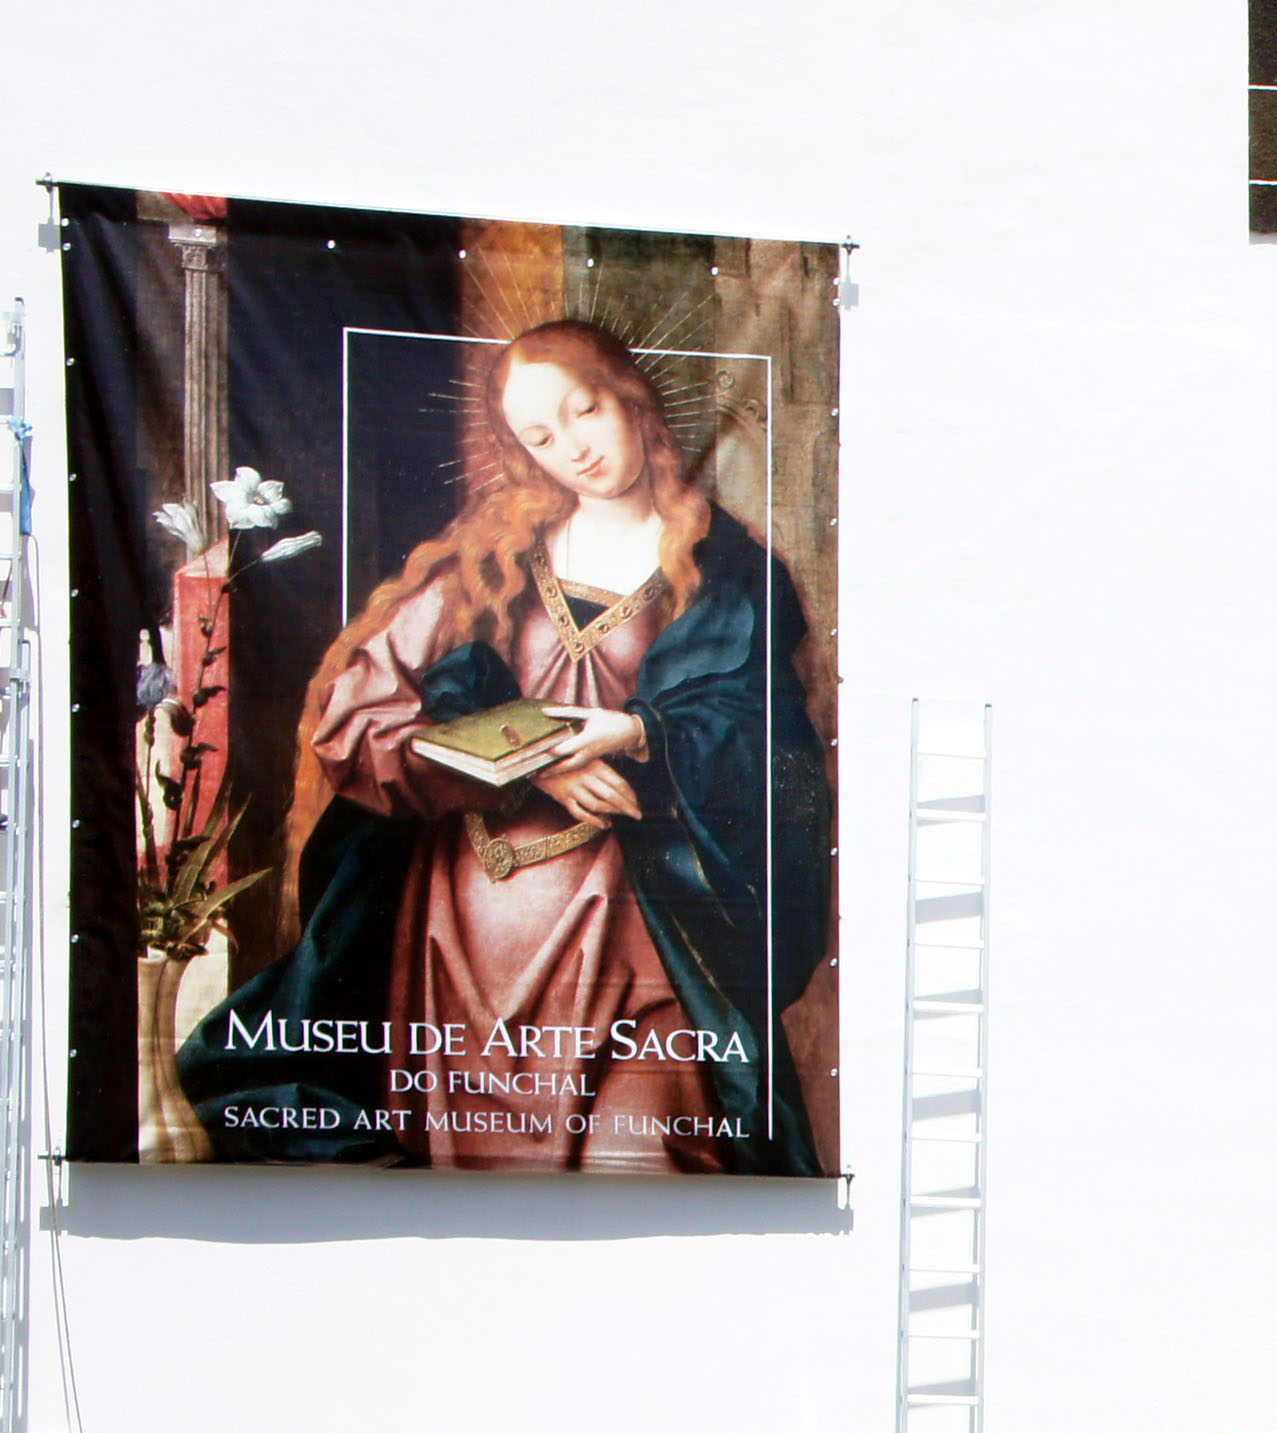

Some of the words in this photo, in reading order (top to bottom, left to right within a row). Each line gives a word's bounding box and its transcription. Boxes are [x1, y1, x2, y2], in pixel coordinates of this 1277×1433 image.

[224, 1009, 392, 1054] MUSEU
[408, 1024, 466, 1056] DE
[480, 1018, 597, 1060] ARTE
[610, 1018, 750, 1064] SACRA
[390, 1068, 438, 1095] DO
[448, 1071, 596, 1098] FUNCHAL
[223, 1105, 342, 1131] SACRED
[353, 1107, 412, 1132] ART
[424, 1110, 555, 1135] MUSEUM
[565, 1113, 601, 1135] OF
[613, 1114, 751, 1140] FUNCHAL
